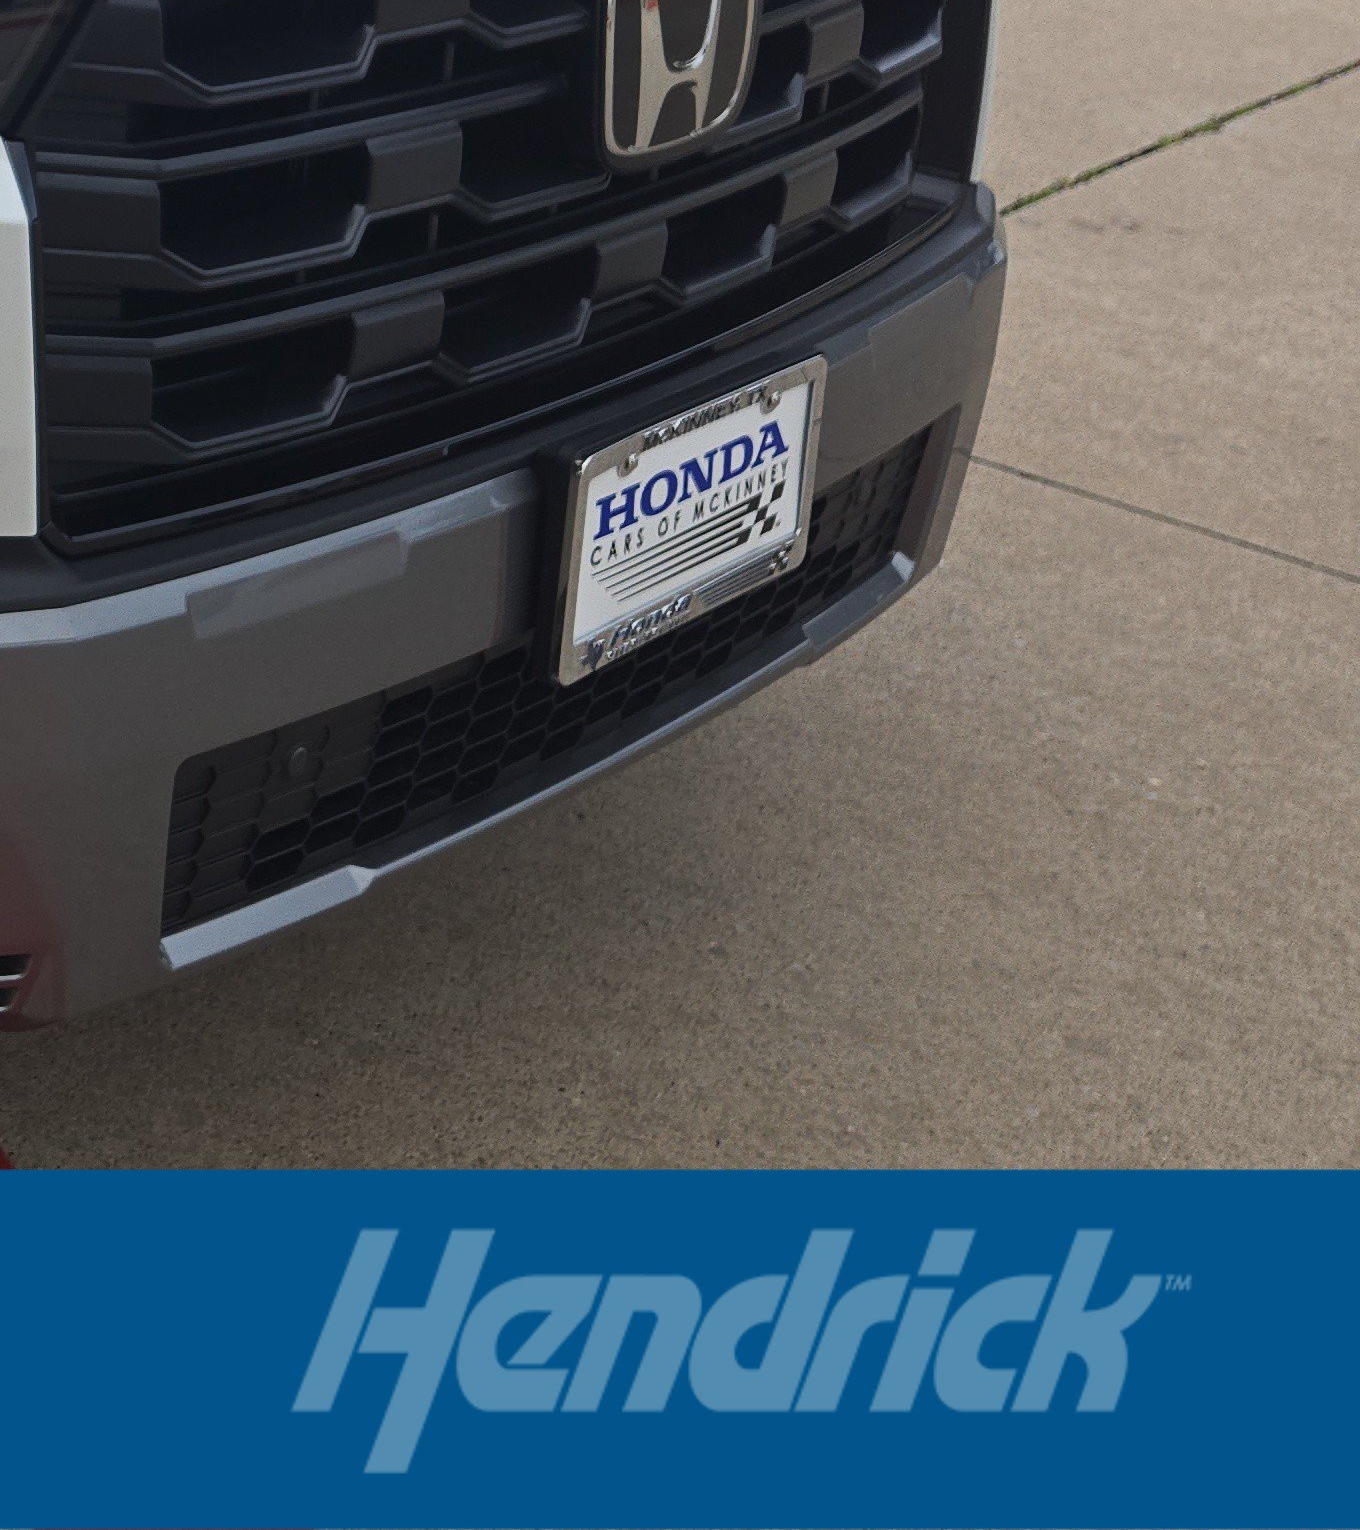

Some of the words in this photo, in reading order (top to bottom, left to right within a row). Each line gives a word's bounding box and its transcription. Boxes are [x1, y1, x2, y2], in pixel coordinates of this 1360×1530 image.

[590, 527, 645, 566] CARS
[657, 511, 682, 537] OF
[692, 458, 789, 522] MCKINNEY
[593, 420, 789, 541] HONDA
